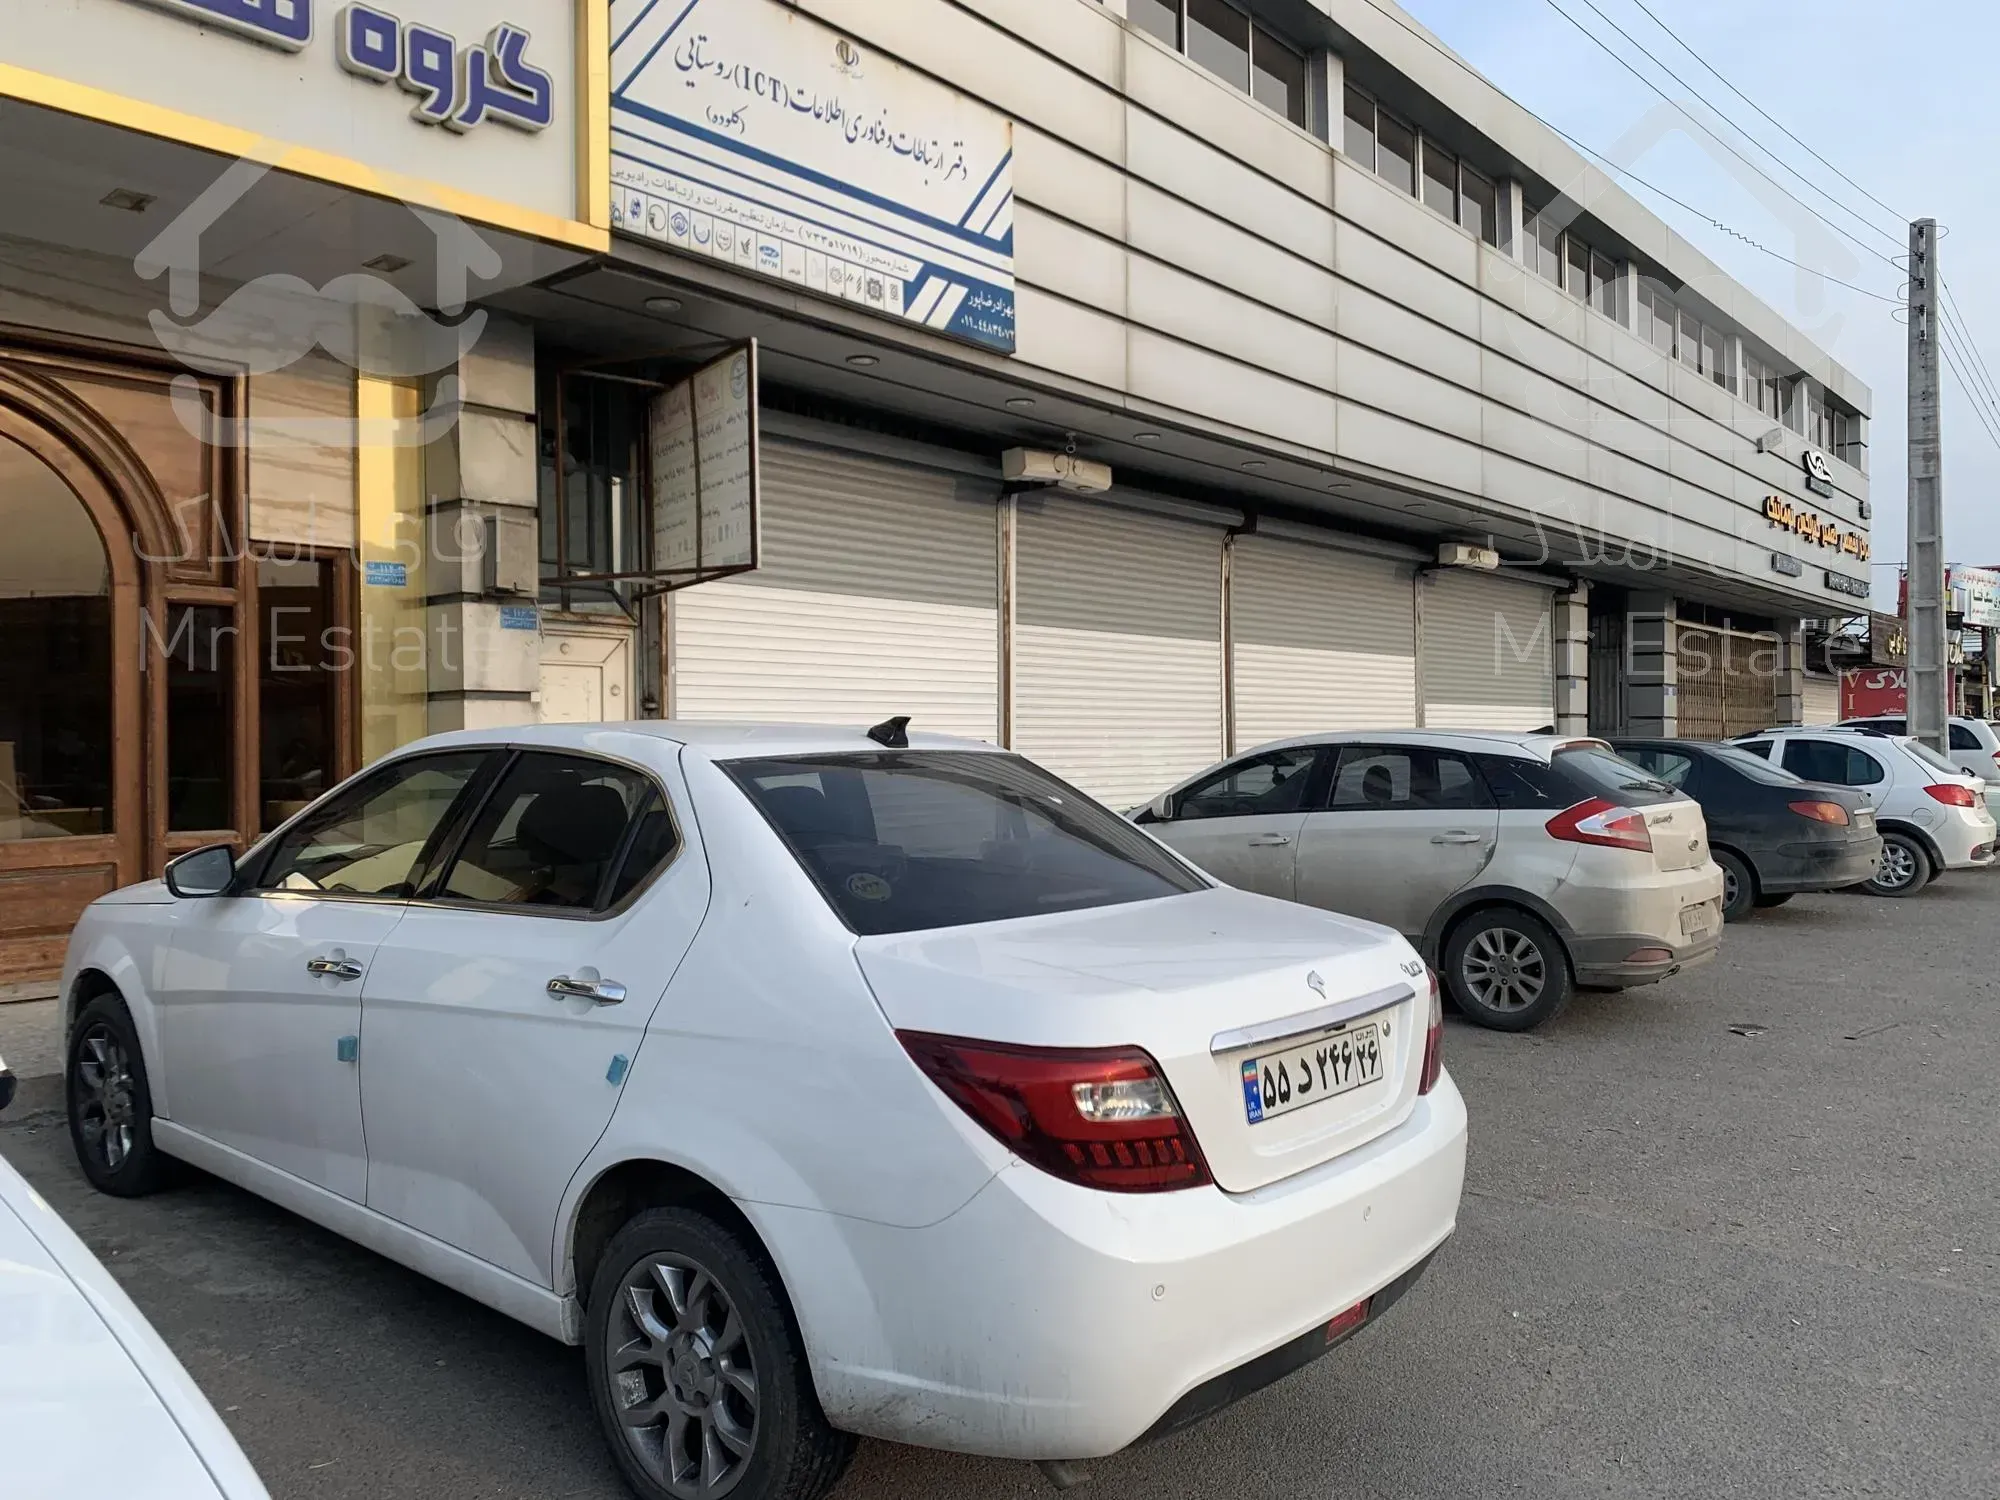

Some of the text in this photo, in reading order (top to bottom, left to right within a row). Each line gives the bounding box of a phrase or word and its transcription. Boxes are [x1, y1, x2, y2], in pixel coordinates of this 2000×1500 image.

[335, 1, 554, 134] گروه
[705, 105, 749, 134] (کلوده)
[845, 108, 887, 145] فناوری
[893, 133, 943, 186] ارتباطات
[944, 140, 967, 181] دفتر
[650, 177, 694, 201] ارتباطات
[702, 196, 738, 214] مقررات
[765, 216, 795, 234] سازمان
[1263, 1039, 1378, 1109] ۵۵ د ۲۴۶ ۲۶
